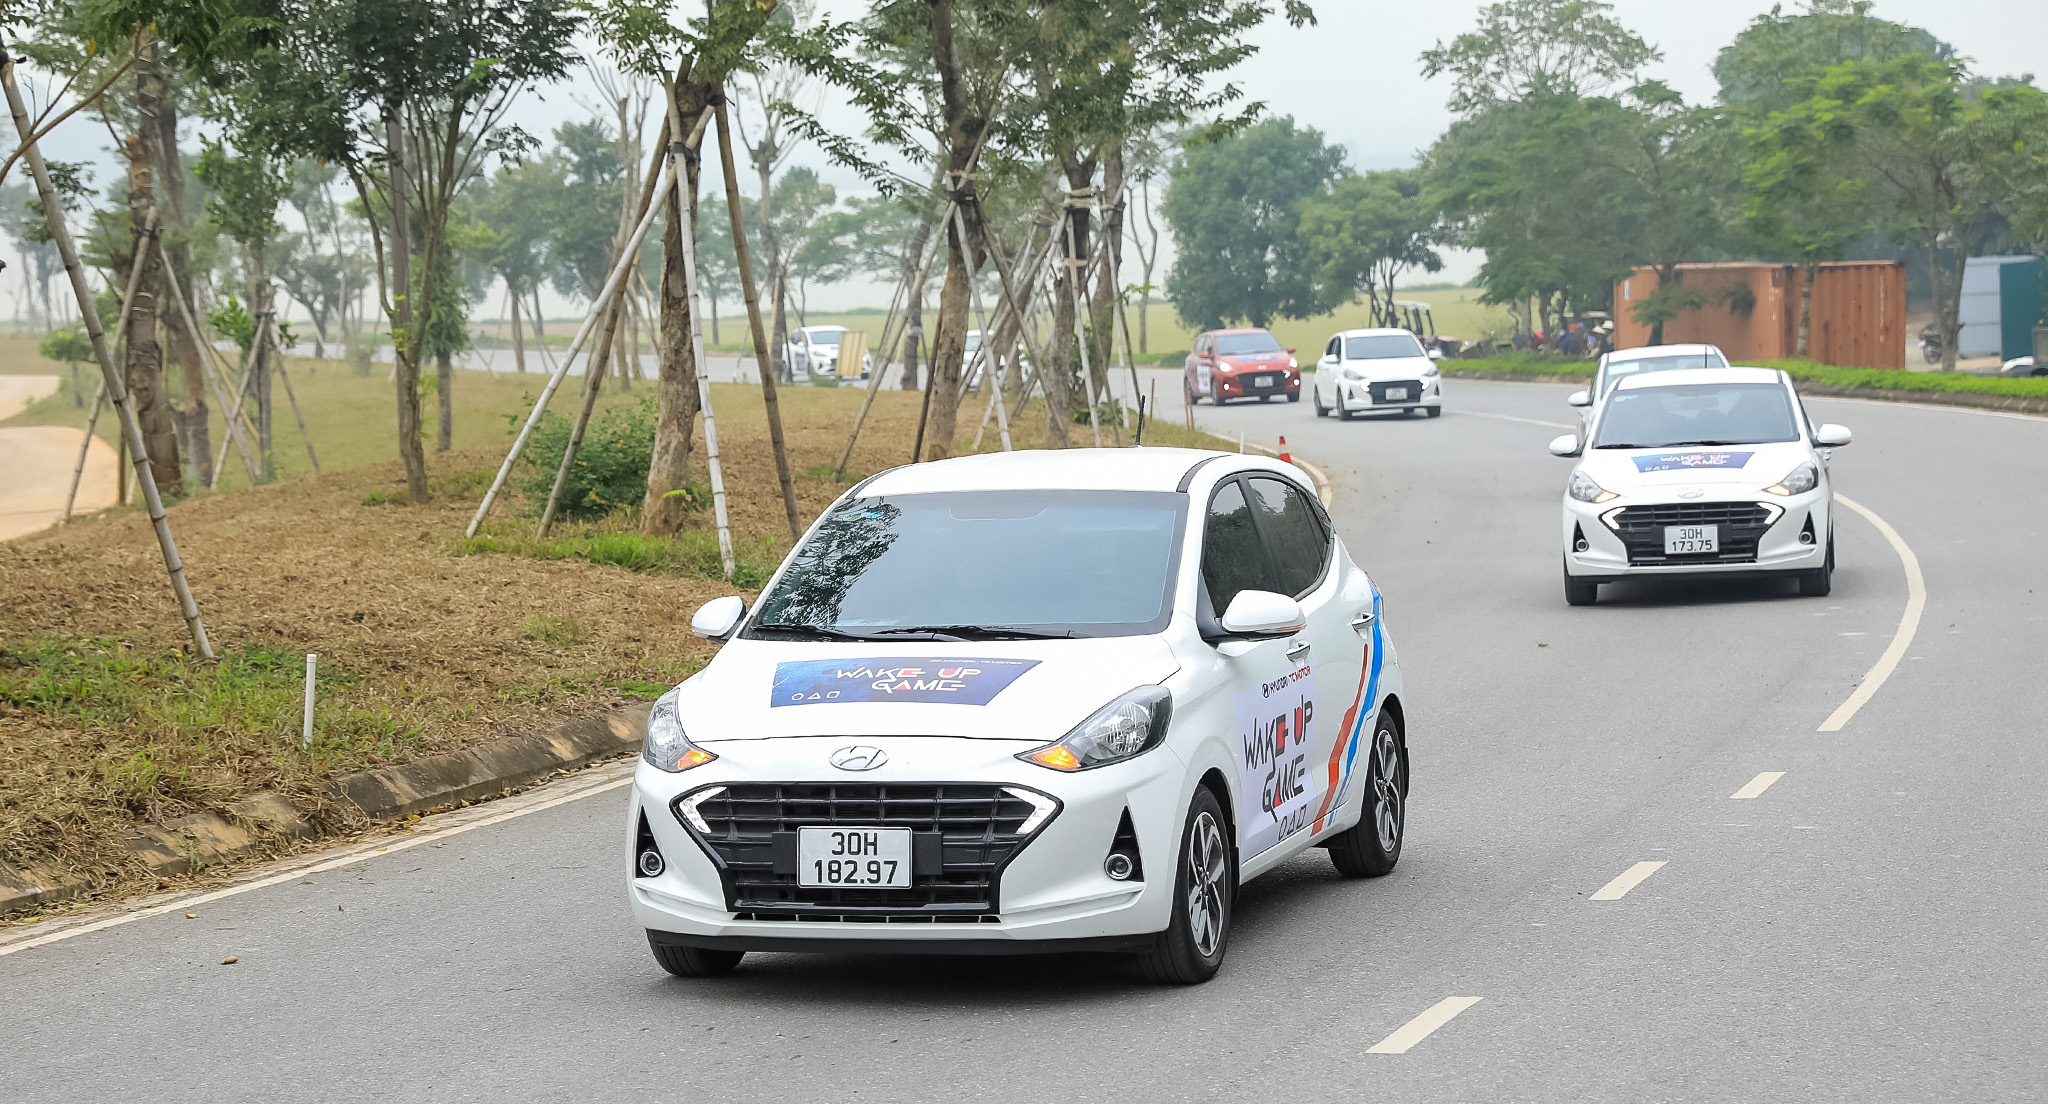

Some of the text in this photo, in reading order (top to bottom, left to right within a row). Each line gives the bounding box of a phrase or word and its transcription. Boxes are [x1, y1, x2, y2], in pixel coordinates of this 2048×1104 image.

[1679, 528, 1703, 539] 30H
[1672, 540, 1712, 552] 173.75
[836, 666, 982, 682] WAKE UP
[871, 679, 966, 694] GAME
[1243, 694, 1313, 773] WAKE UP
[1262, 753, 1305, 823] GAME
[831, 831, 878, 856] 30H
[814, 859, 898, 885] 182.97
